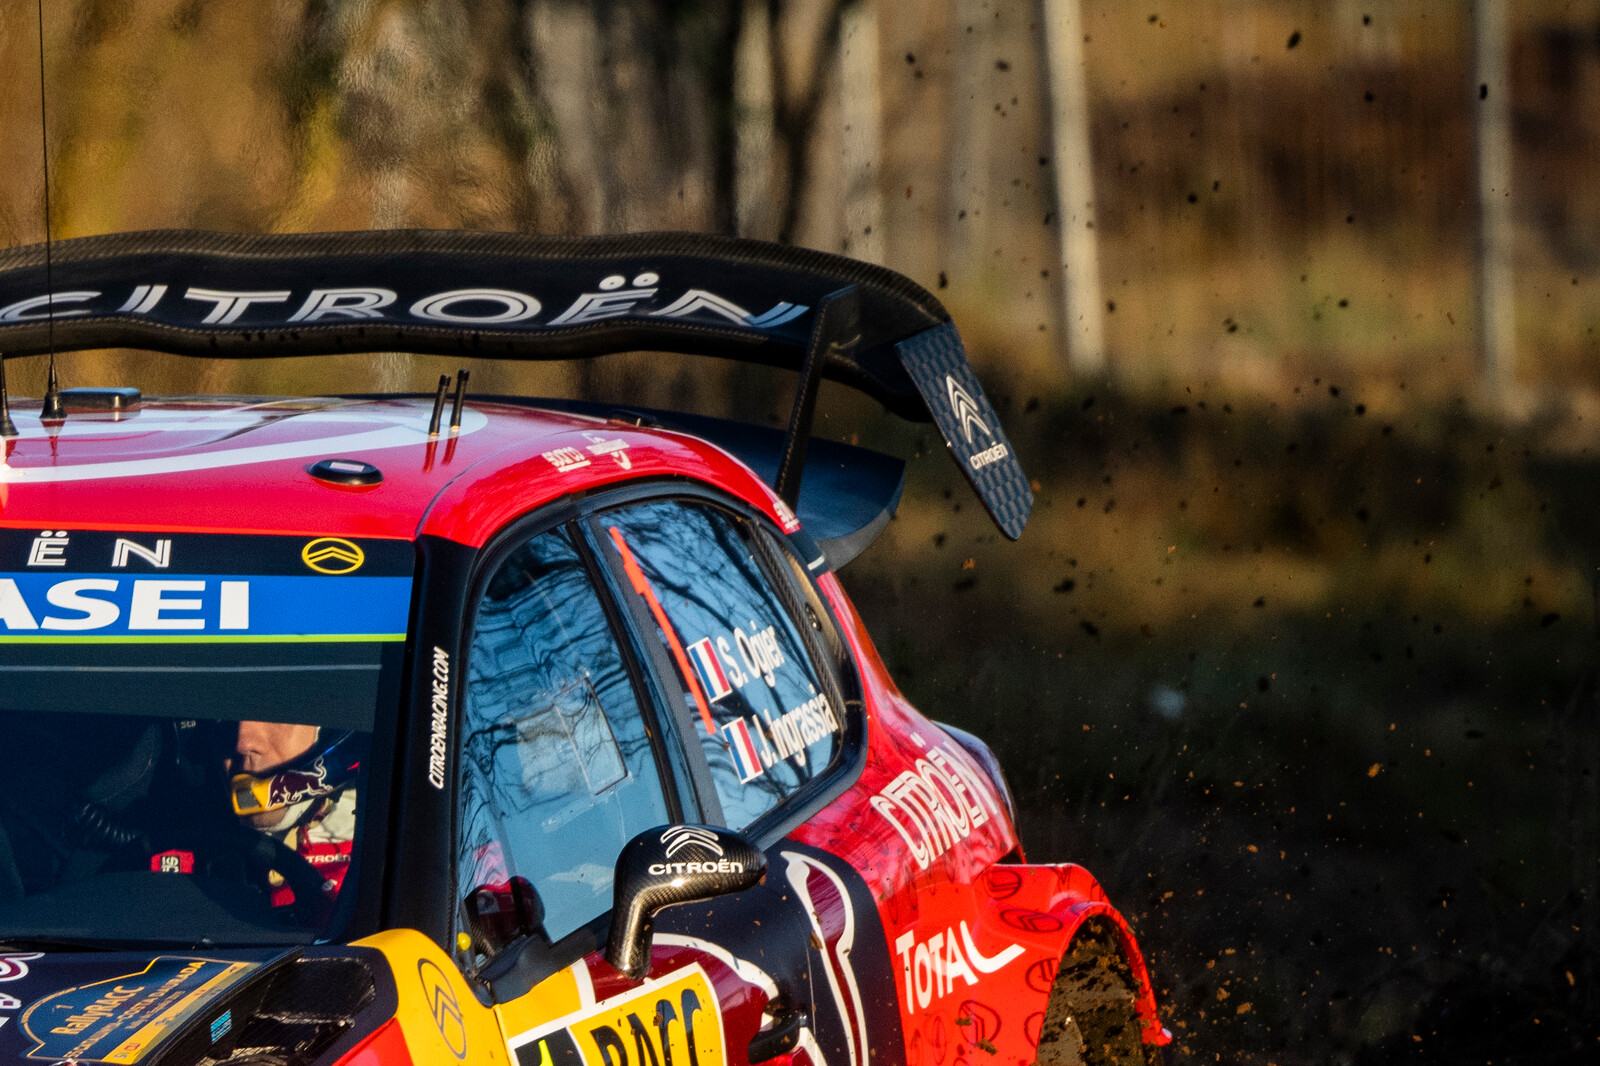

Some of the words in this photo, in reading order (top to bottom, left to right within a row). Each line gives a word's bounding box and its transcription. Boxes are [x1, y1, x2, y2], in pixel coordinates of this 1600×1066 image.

[969, 441, 1009, 470] CITROËN
[428, 645, 450, 790] CITROENRACING.COM
[764, 684, 839, 768] Ingrassia
[869, 731, 999, 870] CITROËN
[648, 857, 744, 876] CITROËN
[895, 920, 1027, 1015] TOTAL
